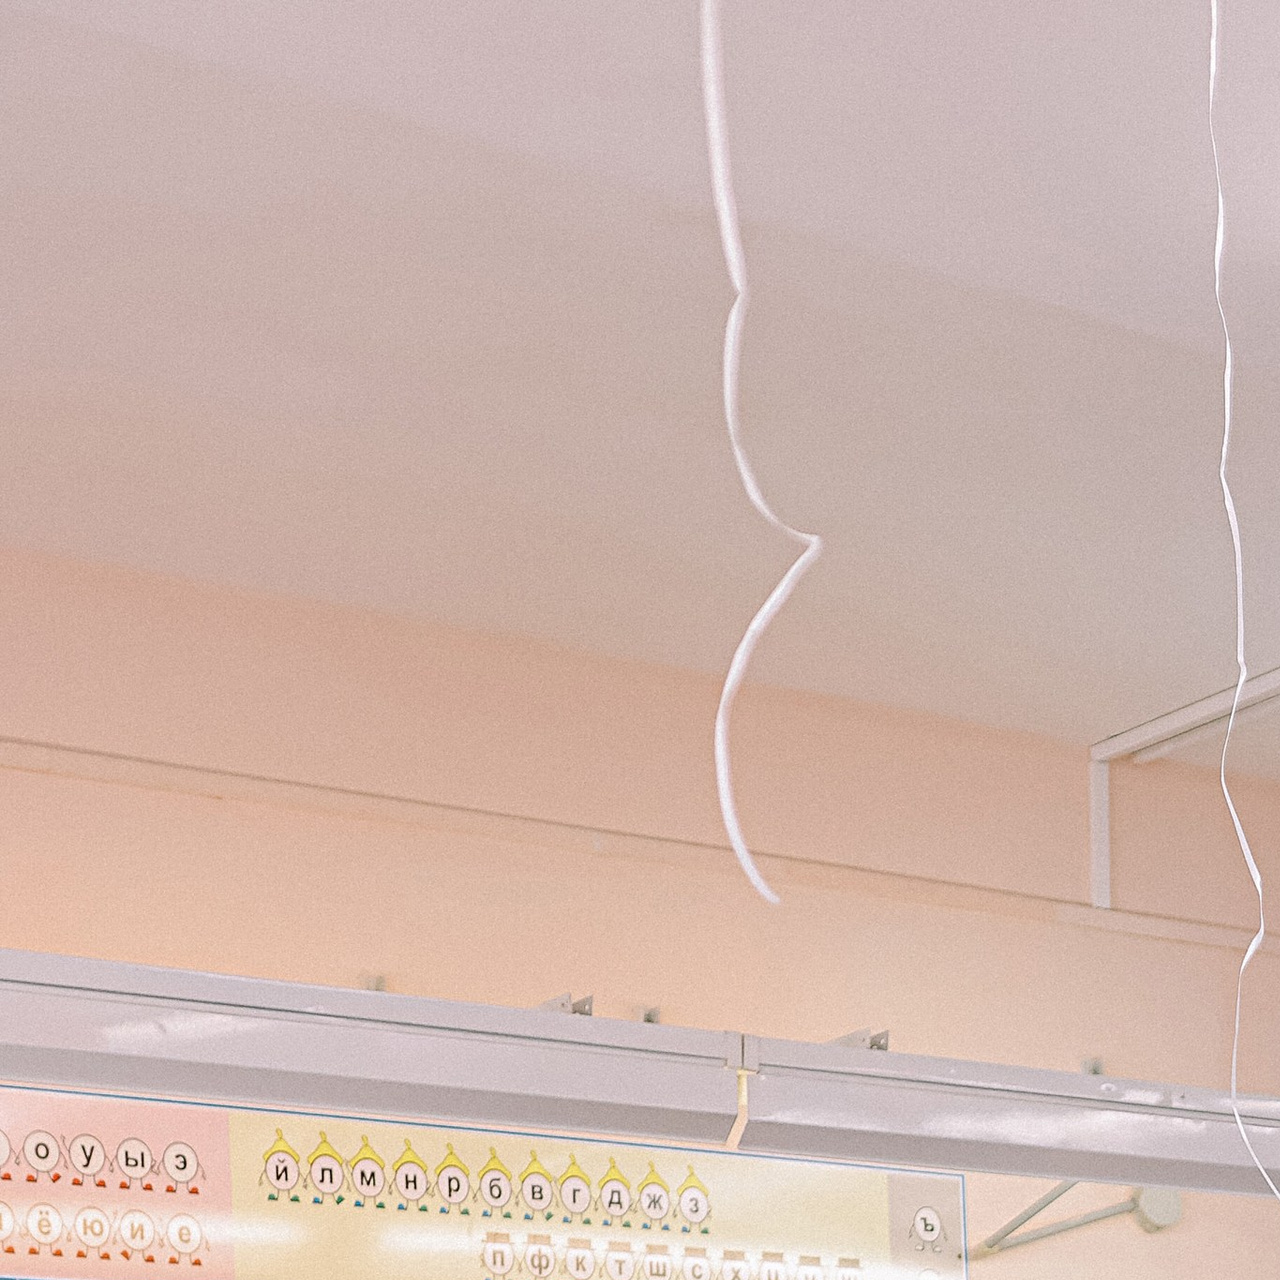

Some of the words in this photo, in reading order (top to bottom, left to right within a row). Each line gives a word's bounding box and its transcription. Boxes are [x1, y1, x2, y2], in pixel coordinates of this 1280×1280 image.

[80, 1144, 95, 1168] у
[124, 1150, 145, 1169] ы
[174, 1153, 188, 1171] э
[319, 1167, 334, 1185] л
[360, 1170, 377, 1187] м
[404, 1173, 418, 1191] н
[489, 1177, 502, 1199] б
[531, 1184, 544, 1201] в
[572, 1188, 582, 1204] г
[608, 1190, 623, 1209] д
[645, 1193, 663, 1211] ж
[83, 1219, 104, 1238] ю
[130, 1222, 144, 1241] и
[530, 1249, 550, 1275] ф
